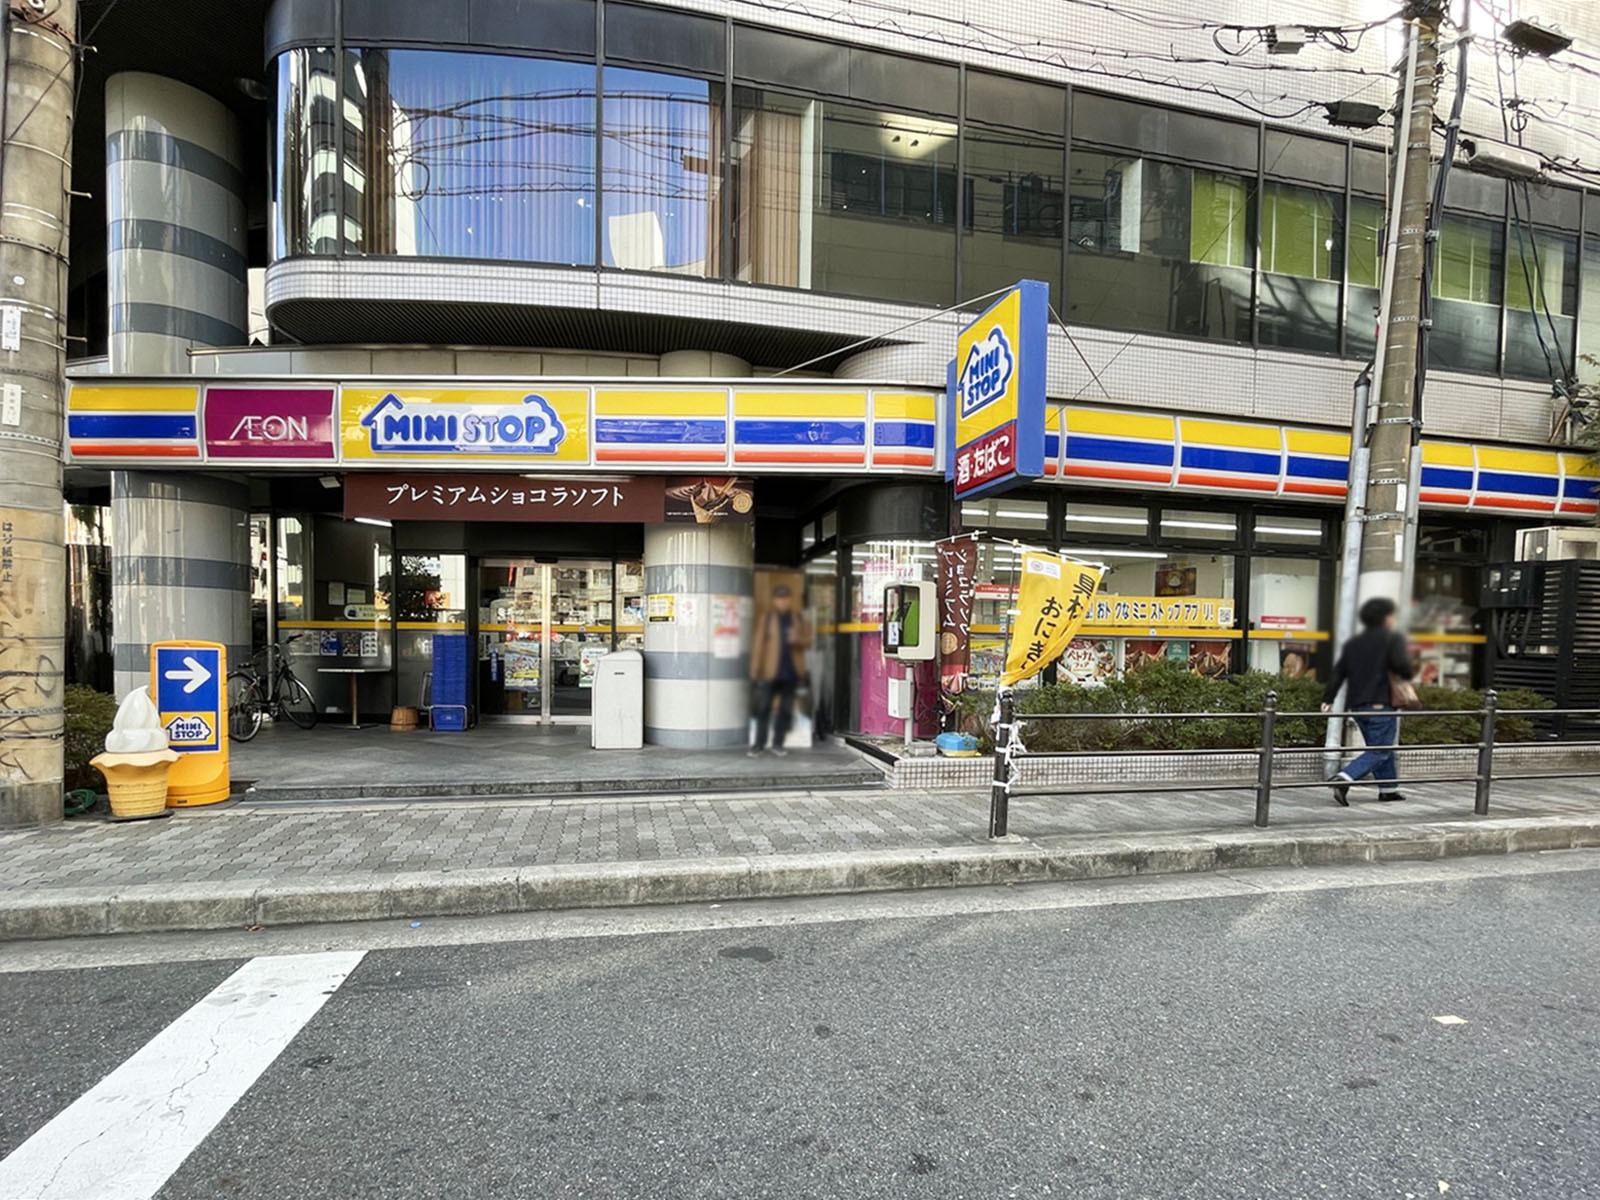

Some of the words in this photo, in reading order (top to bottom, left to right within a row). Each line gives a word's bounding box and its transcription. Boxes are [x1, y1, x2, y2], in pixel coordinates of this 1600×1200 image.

[969, 346, 1000, 384] MINI
[967, 368, 1000, 406] STOP
[384, 415, 457, 441] MINI
[463, 415, 546, 442] STOP
[387, 483, 624, 507] プレミアムショコラソフト
[2, 522, 13, 583] はり紙禁止
